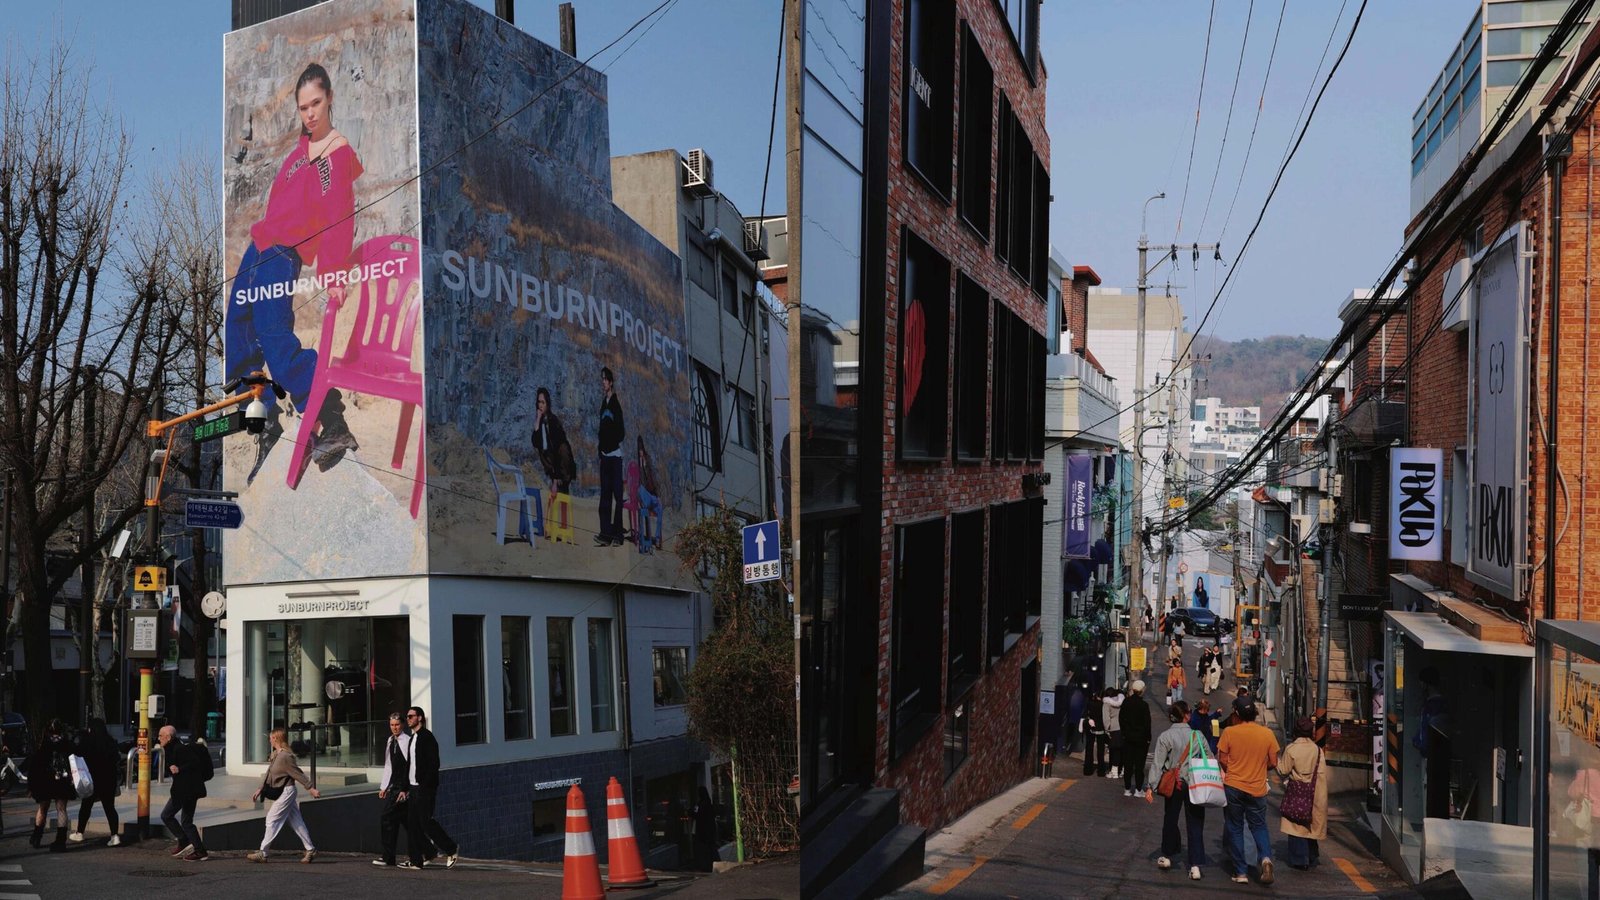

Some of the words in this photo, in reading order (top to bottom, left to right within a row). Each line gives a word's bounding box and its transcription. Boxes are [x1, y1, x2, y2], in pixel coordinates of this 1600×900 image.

[235, 257, 408, 306] SUNBURNPROJECT
[441, 249, 682, 372] SUNBURNPROJECT
[745, 563, 779, 579] 일방통행
[278, 600, 370, 613] SUNBURNPROJECT
